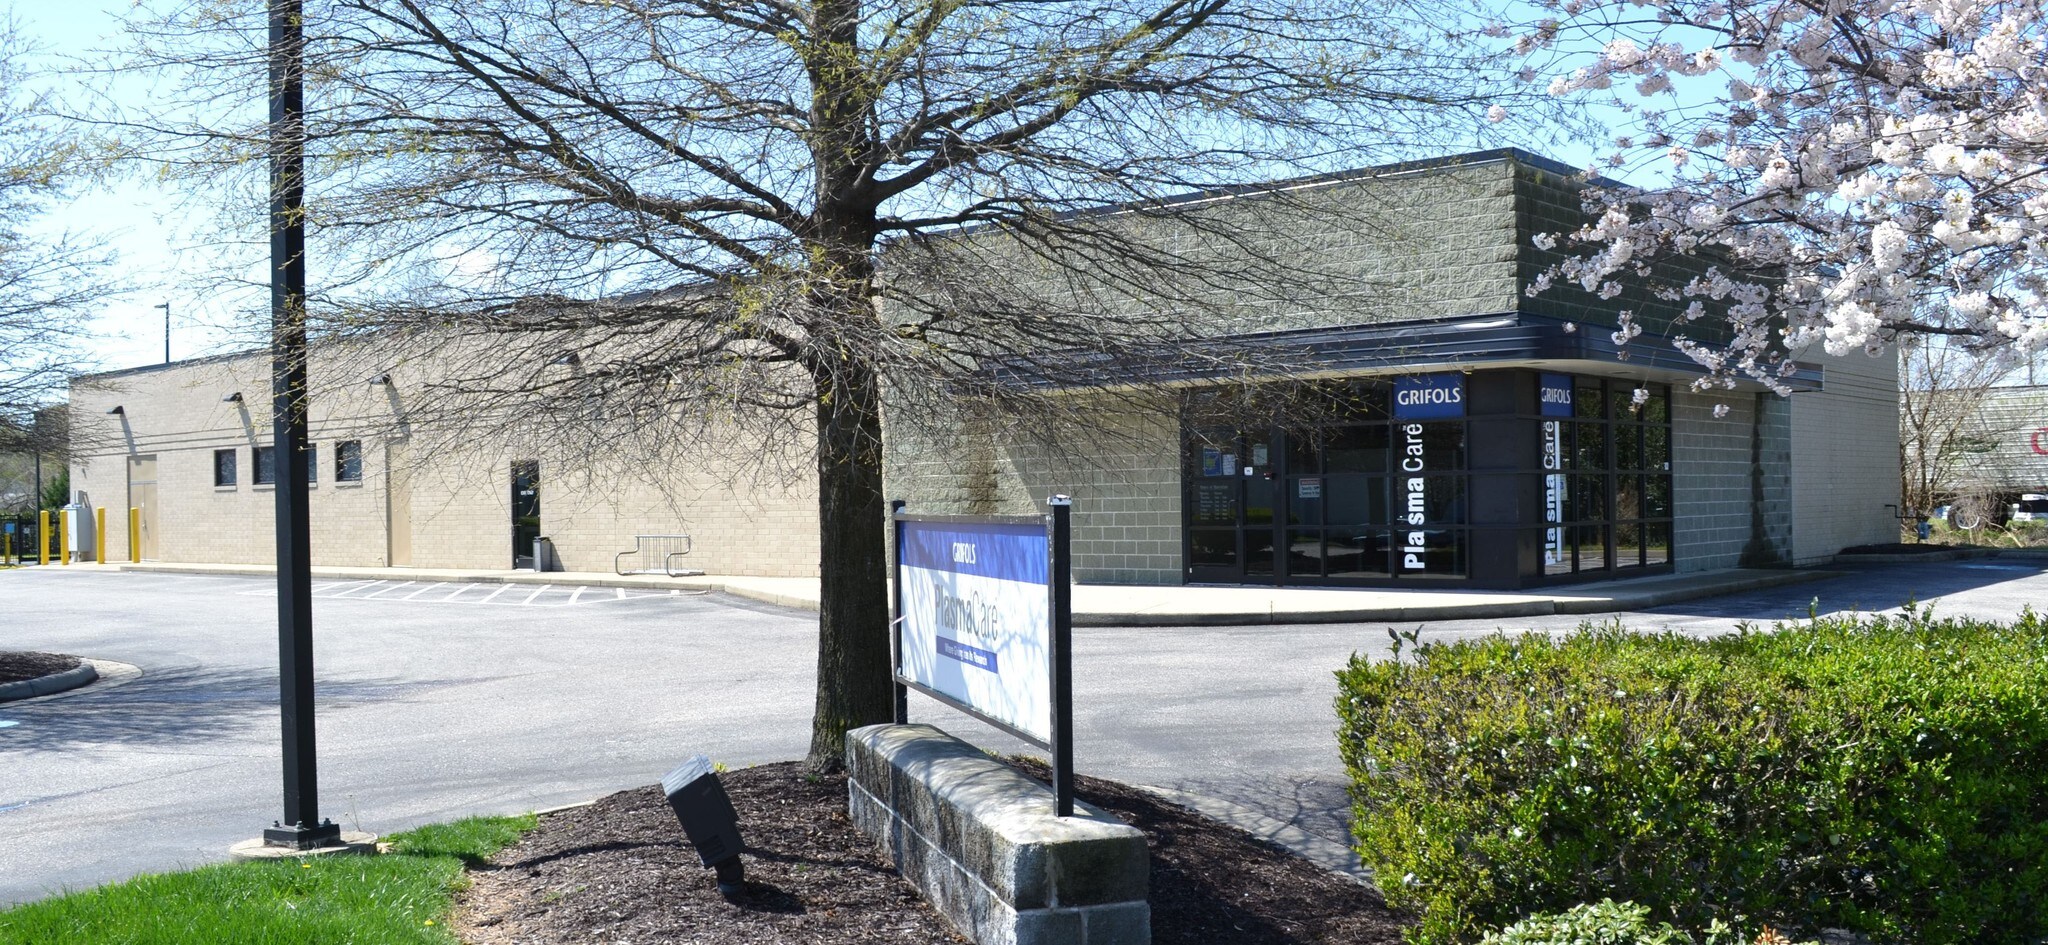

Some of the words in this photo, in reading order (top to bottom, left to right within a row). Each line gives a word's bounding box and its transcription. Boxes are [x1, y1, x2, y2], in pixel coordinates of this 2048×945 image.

[1397, 387, 1461, 406] GRIFOLS
[1541, 387, 1571, 404] GRIFOLS
[1402, 423, 1424, 472] Care
[1543, 420, 1555, 470] Care
